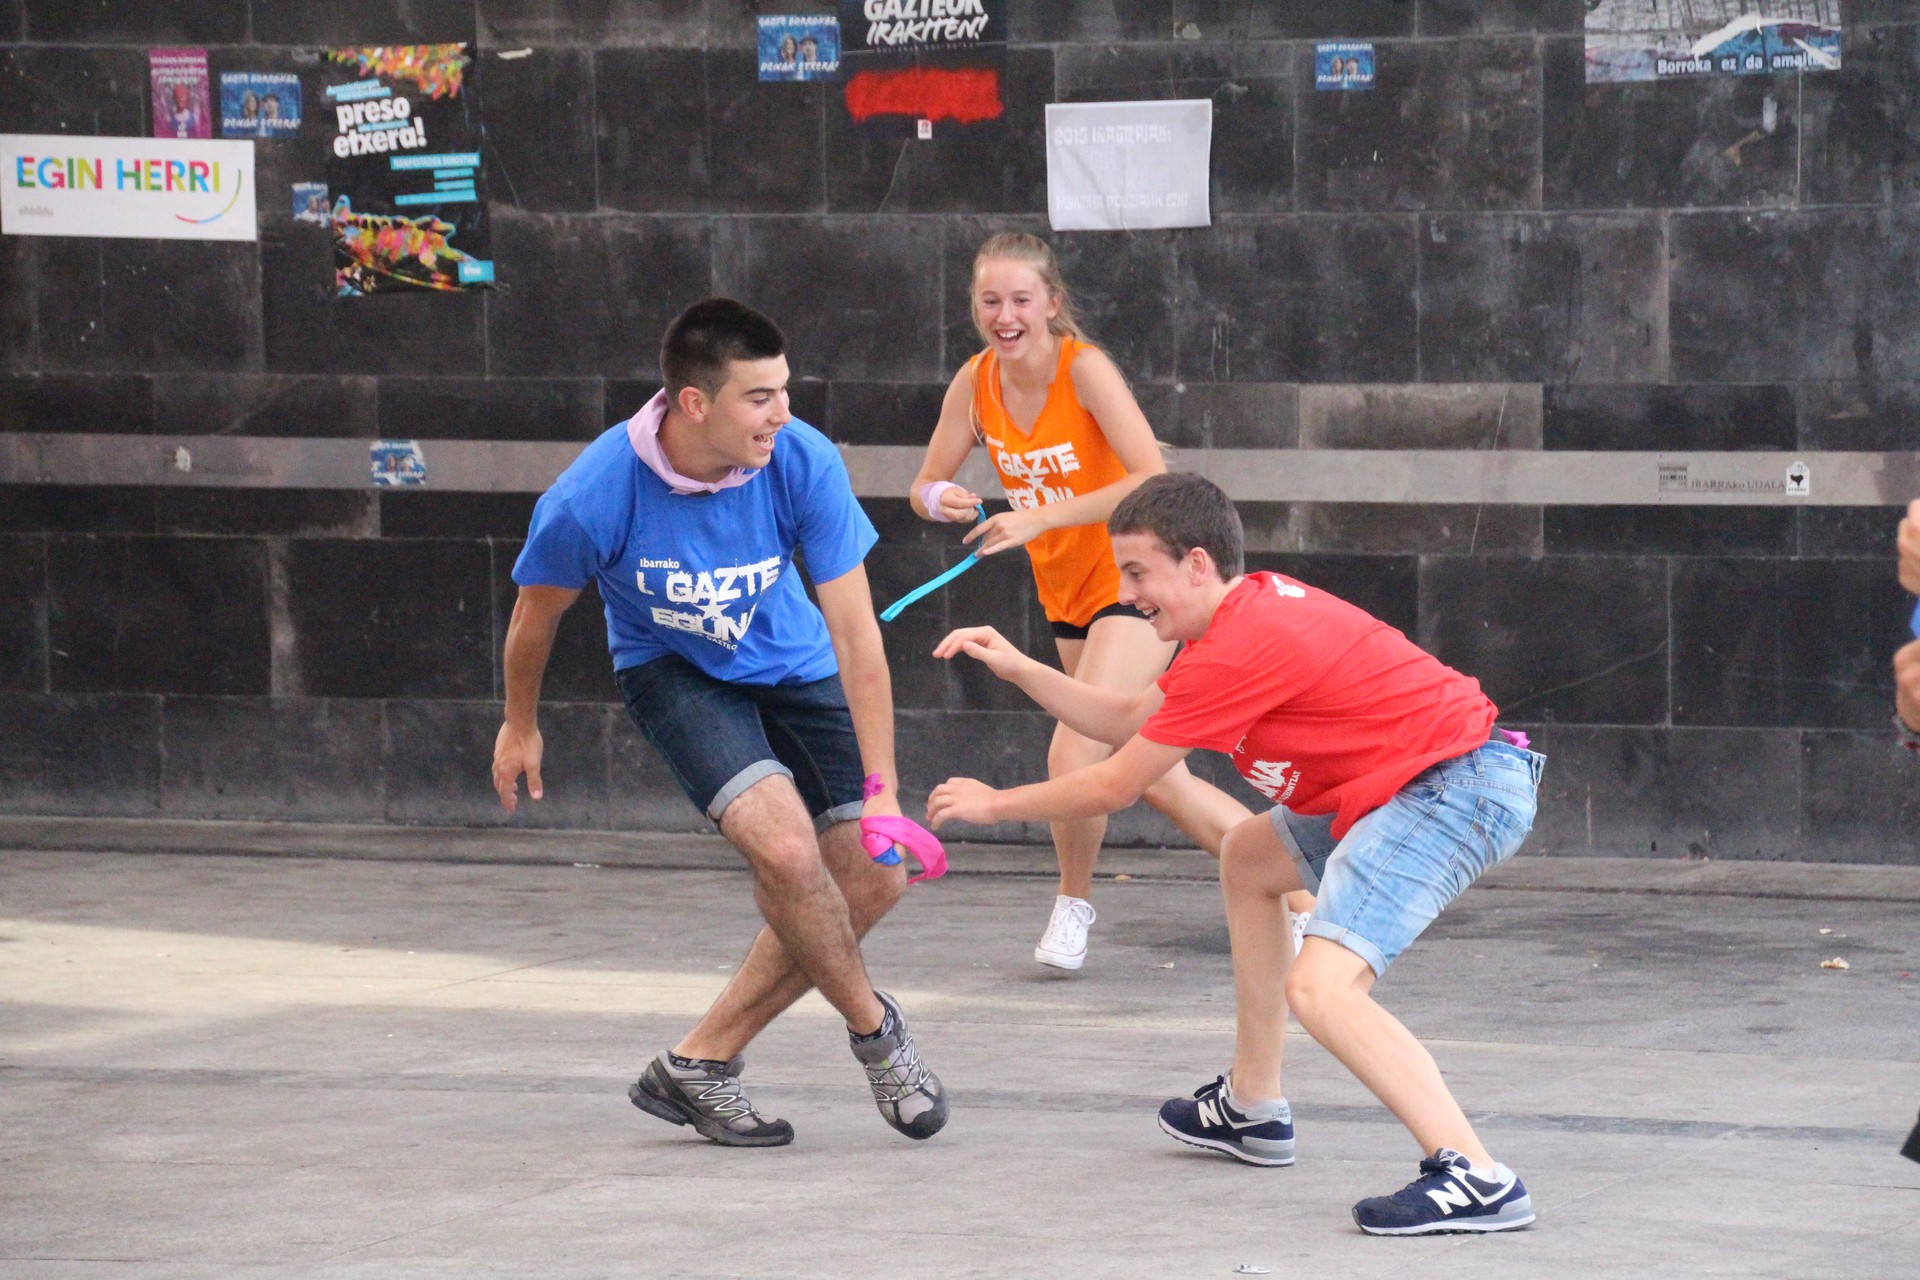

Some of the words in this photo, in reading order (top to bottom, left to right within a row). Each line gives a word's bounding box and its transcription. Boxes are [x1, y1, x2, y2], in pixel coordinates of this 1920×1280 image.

[866, 12, 989, 46] IRAKITEN!
[1657, 57, 1712, 75] Borroka
[1721, 56, 1737, 71] ez
[1746, 53, 1763, 70] da
[336, 96, 411, 134] preso
[333, 116, 428, 158] etxera!
[16, 155, 103, 190] EGIN
[116, 158, 221, 193] HERRI
[997, 442, 1081, 479] GAZTE
[639, 557, 681, 569] Ibarrako
[666, 555, 781, 603] GAZTE
[1198, 1099, 1223, 1128] N
[1426, 1181, 1472, 1215] N
